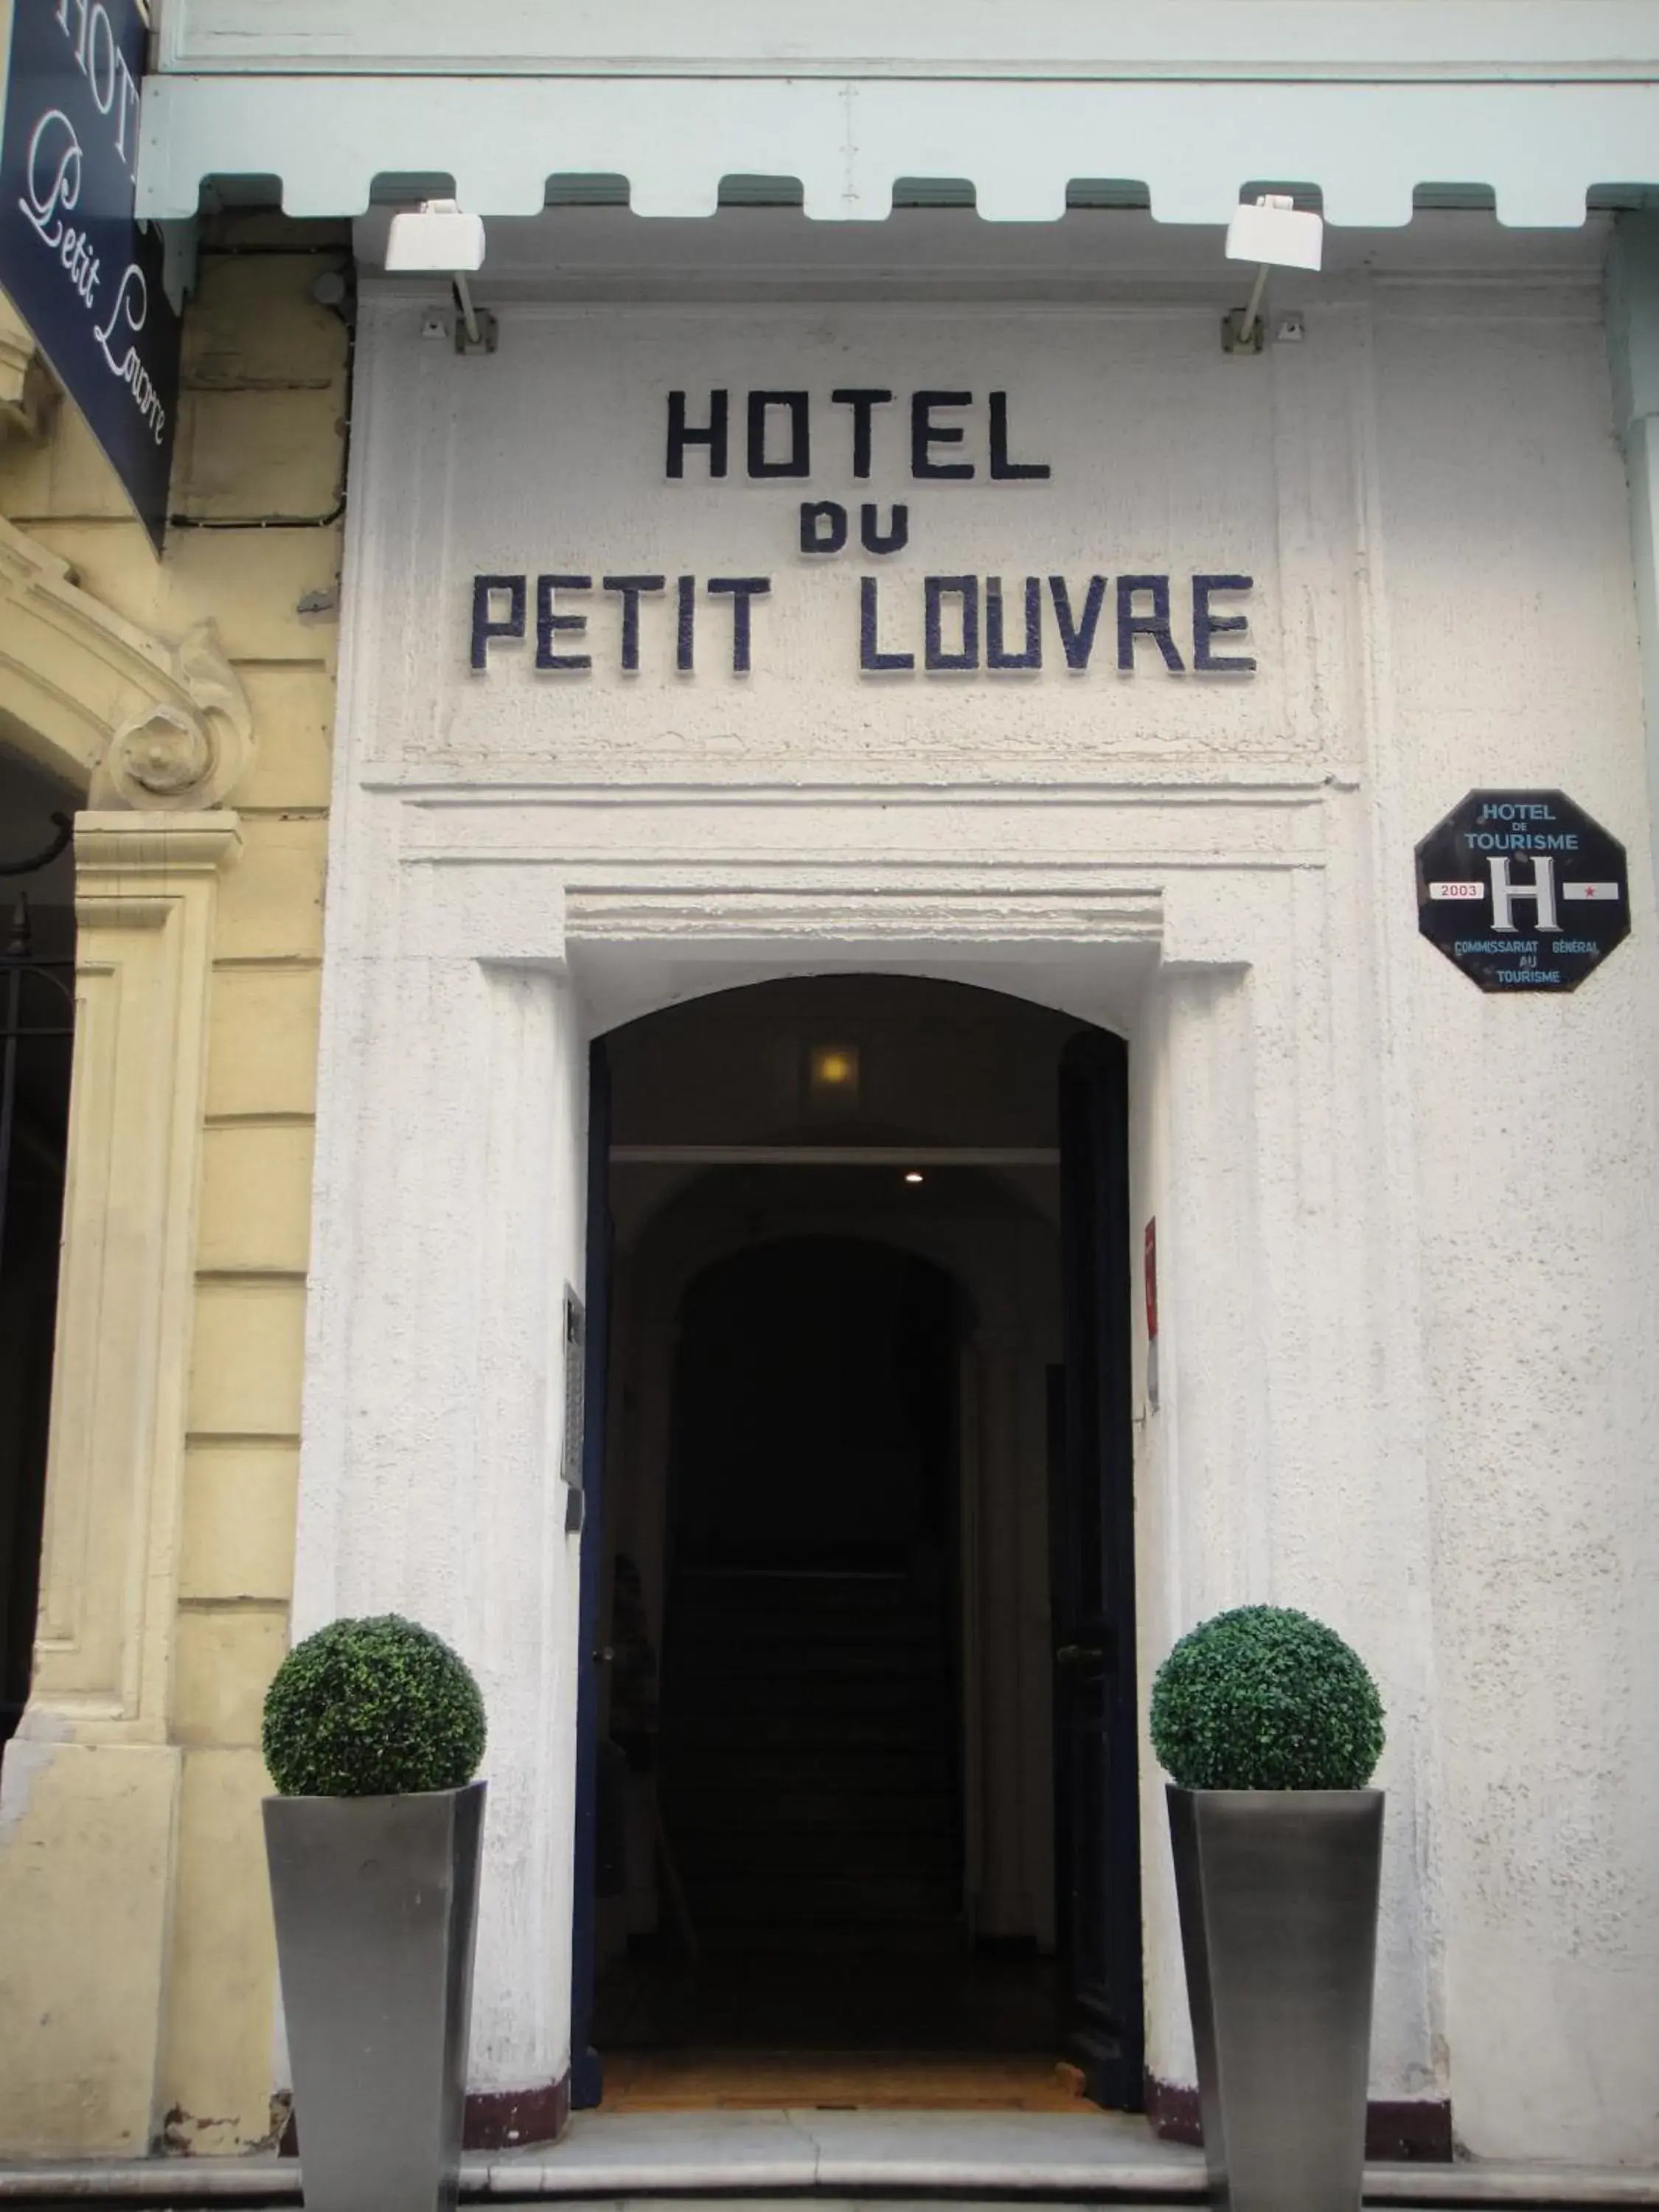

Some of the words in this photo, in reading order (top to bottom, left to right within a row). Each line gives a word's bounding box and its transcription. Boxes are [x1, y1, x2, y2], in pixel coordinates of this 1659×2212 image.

[665, 389, 1051, 481] HOTEL
[800, 500, 908, 555] DU
[470, 574, 771, 672] PETIT
[860, 574, 1256, 674] LOUVRE
[1483, 803, 1556, 821] HOTEL
[1512, 822, 1528, 832] DE
[1464, 832, 1579, 849] TOURISME
[1441, 885, 1477, 896] 2003
[1486, 856, 1563, 932] H
[1455, 940, 1539, 953] COMMISSARIAT
[1519, 956, 1537, 968] AU
[1498, 970, 1561, 983] TOURISME
